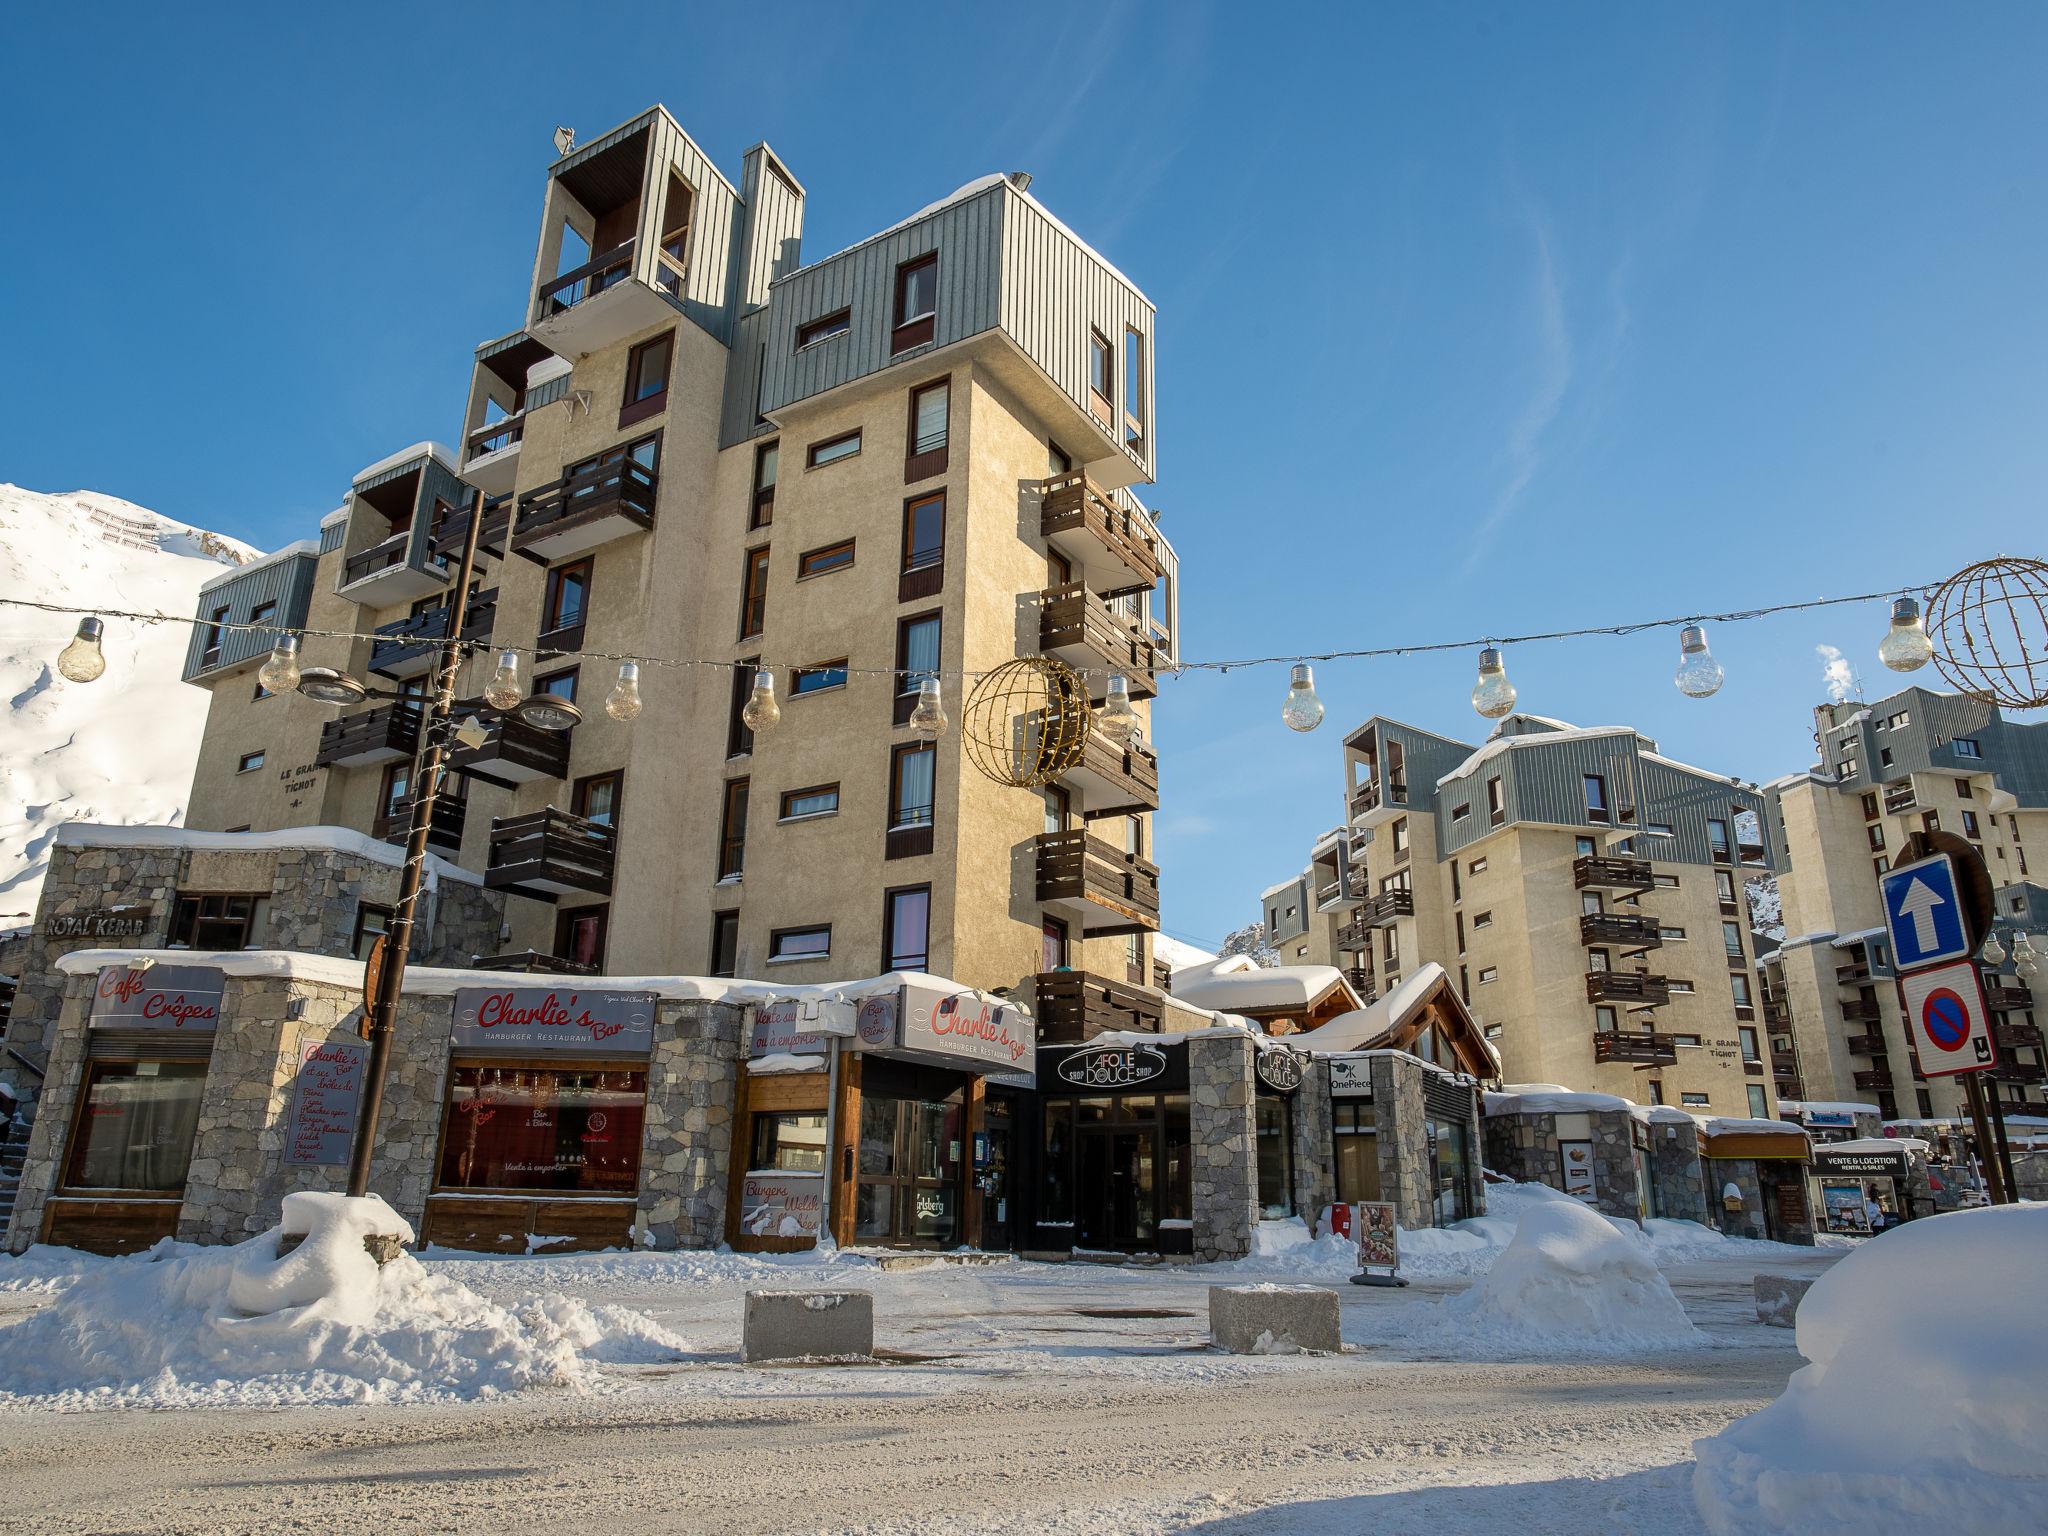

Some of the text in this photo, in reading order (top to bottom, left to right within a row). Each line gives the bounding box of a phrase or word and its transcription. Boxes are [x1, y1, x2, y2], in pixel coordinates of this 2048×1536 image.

[280, 769, 292, 780] LE
[47, 916, 143, 936] ROYAL KEBAB
[98, 968, 145, 1003] Café
[143, 993, 216, 1027] Crêpes
[478, 992, 594, 1028] Charlie's
[868, 1004, 885, 1016] Bar
[931, 998, 1009, 1045] Charlie's
[484, 1031, 592, 1043] HAMBURGER RESTAURANT
[588, 1022, 624, 1041] Bar
[862, 1025, 889, 1038] Bières
[756, 1037, 768, 1048] ou
[779, 1035, 818, 1052] emporter
[939, 1039, 978, 1054] HAMBURGER
[1008, 1039, 1026, 1061] Bar
[305, 1045, 359, 1065] Charlie's
[1069, 1071, 1084, 1081] SHOP
[1086, 1066, 1135, 1084] DOUCE
[1136, 1067, 1152, 1077] SHOP
[1331, 1079, 1372, 1089] OnePiece
[532, 1109, 548, 1118] Bar
[505, 1161, 568, 1174] Vente à emporter
[1827, 1157, 1897, 1165] VENTE & LOCATION
[746, 1181, 789, 1203] Burgers
[785, 1194, 819, 1212] Welsh
